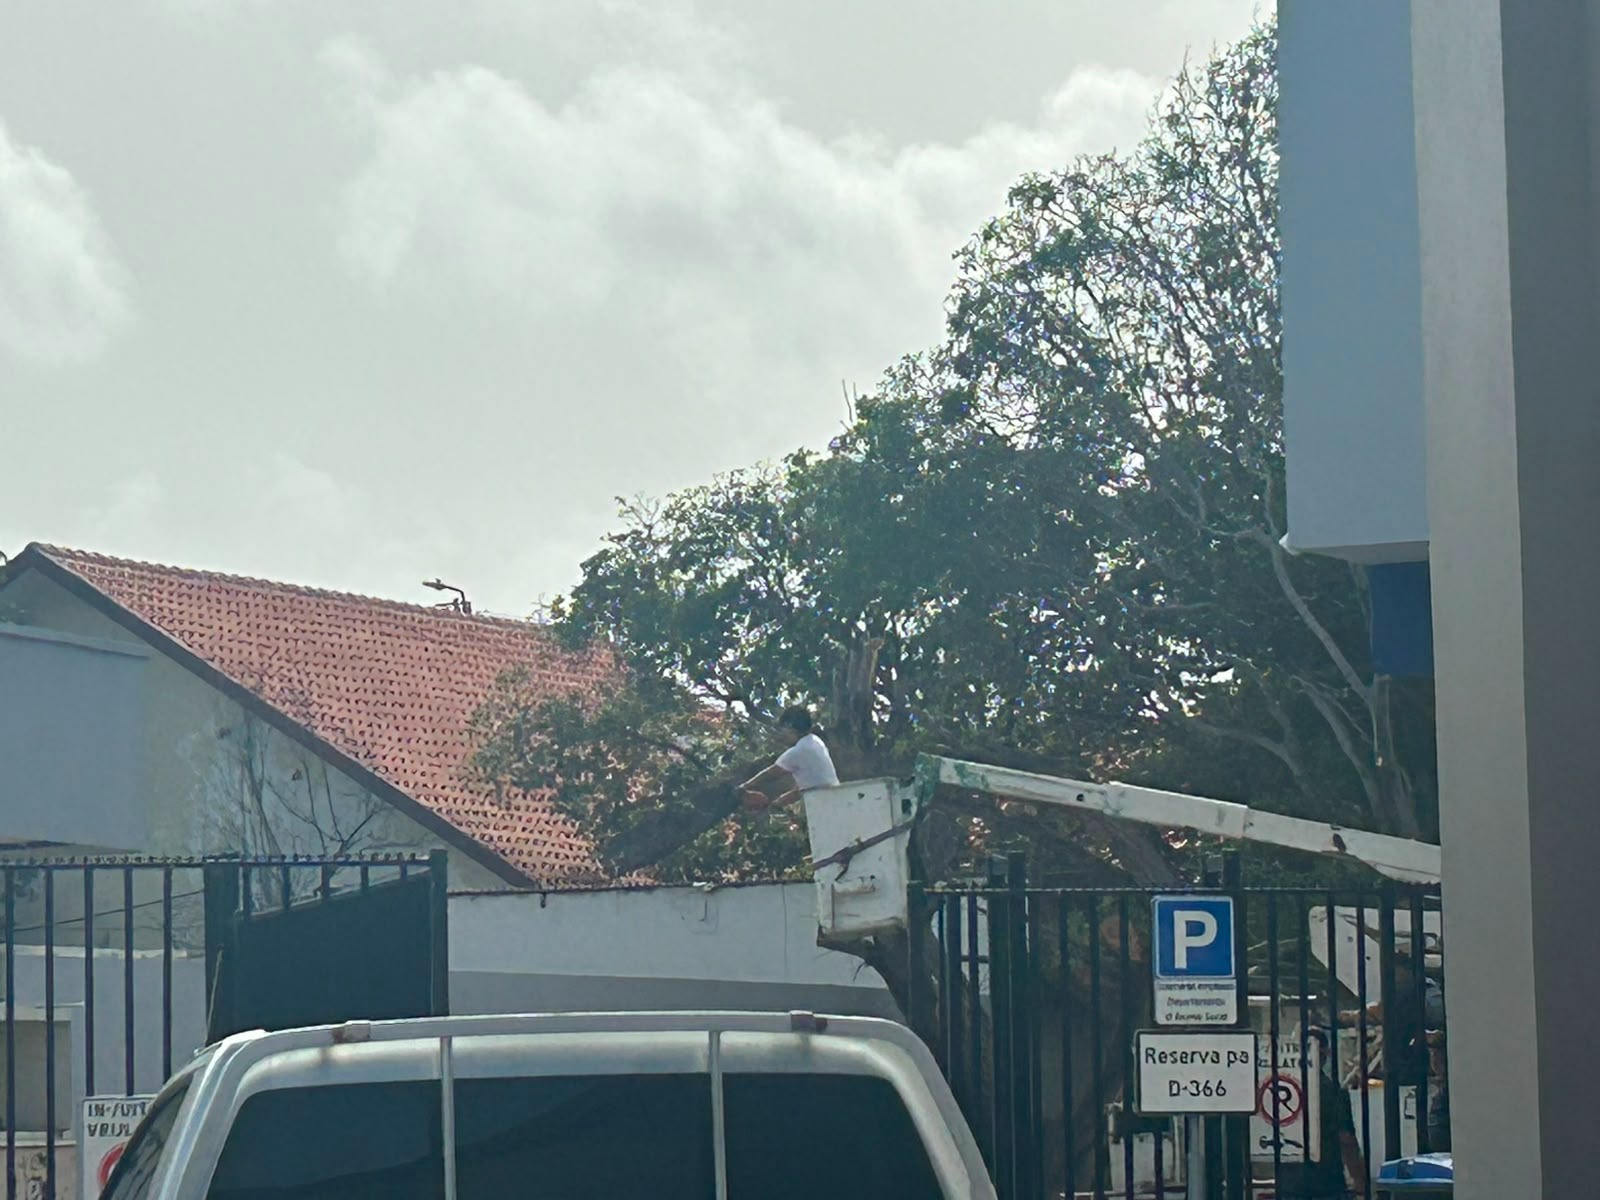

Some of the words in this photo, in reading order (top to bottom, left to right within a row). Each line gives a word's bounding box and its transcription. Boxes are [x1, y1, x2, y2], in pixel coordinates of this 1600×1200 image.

[1173, 910, 1218, 969] P
[1145, 1047, 1220, 1064] Reserva
[1227, 1050, 1249, 1068] pa
[1168, 1080, 1227, 1097] D-366
